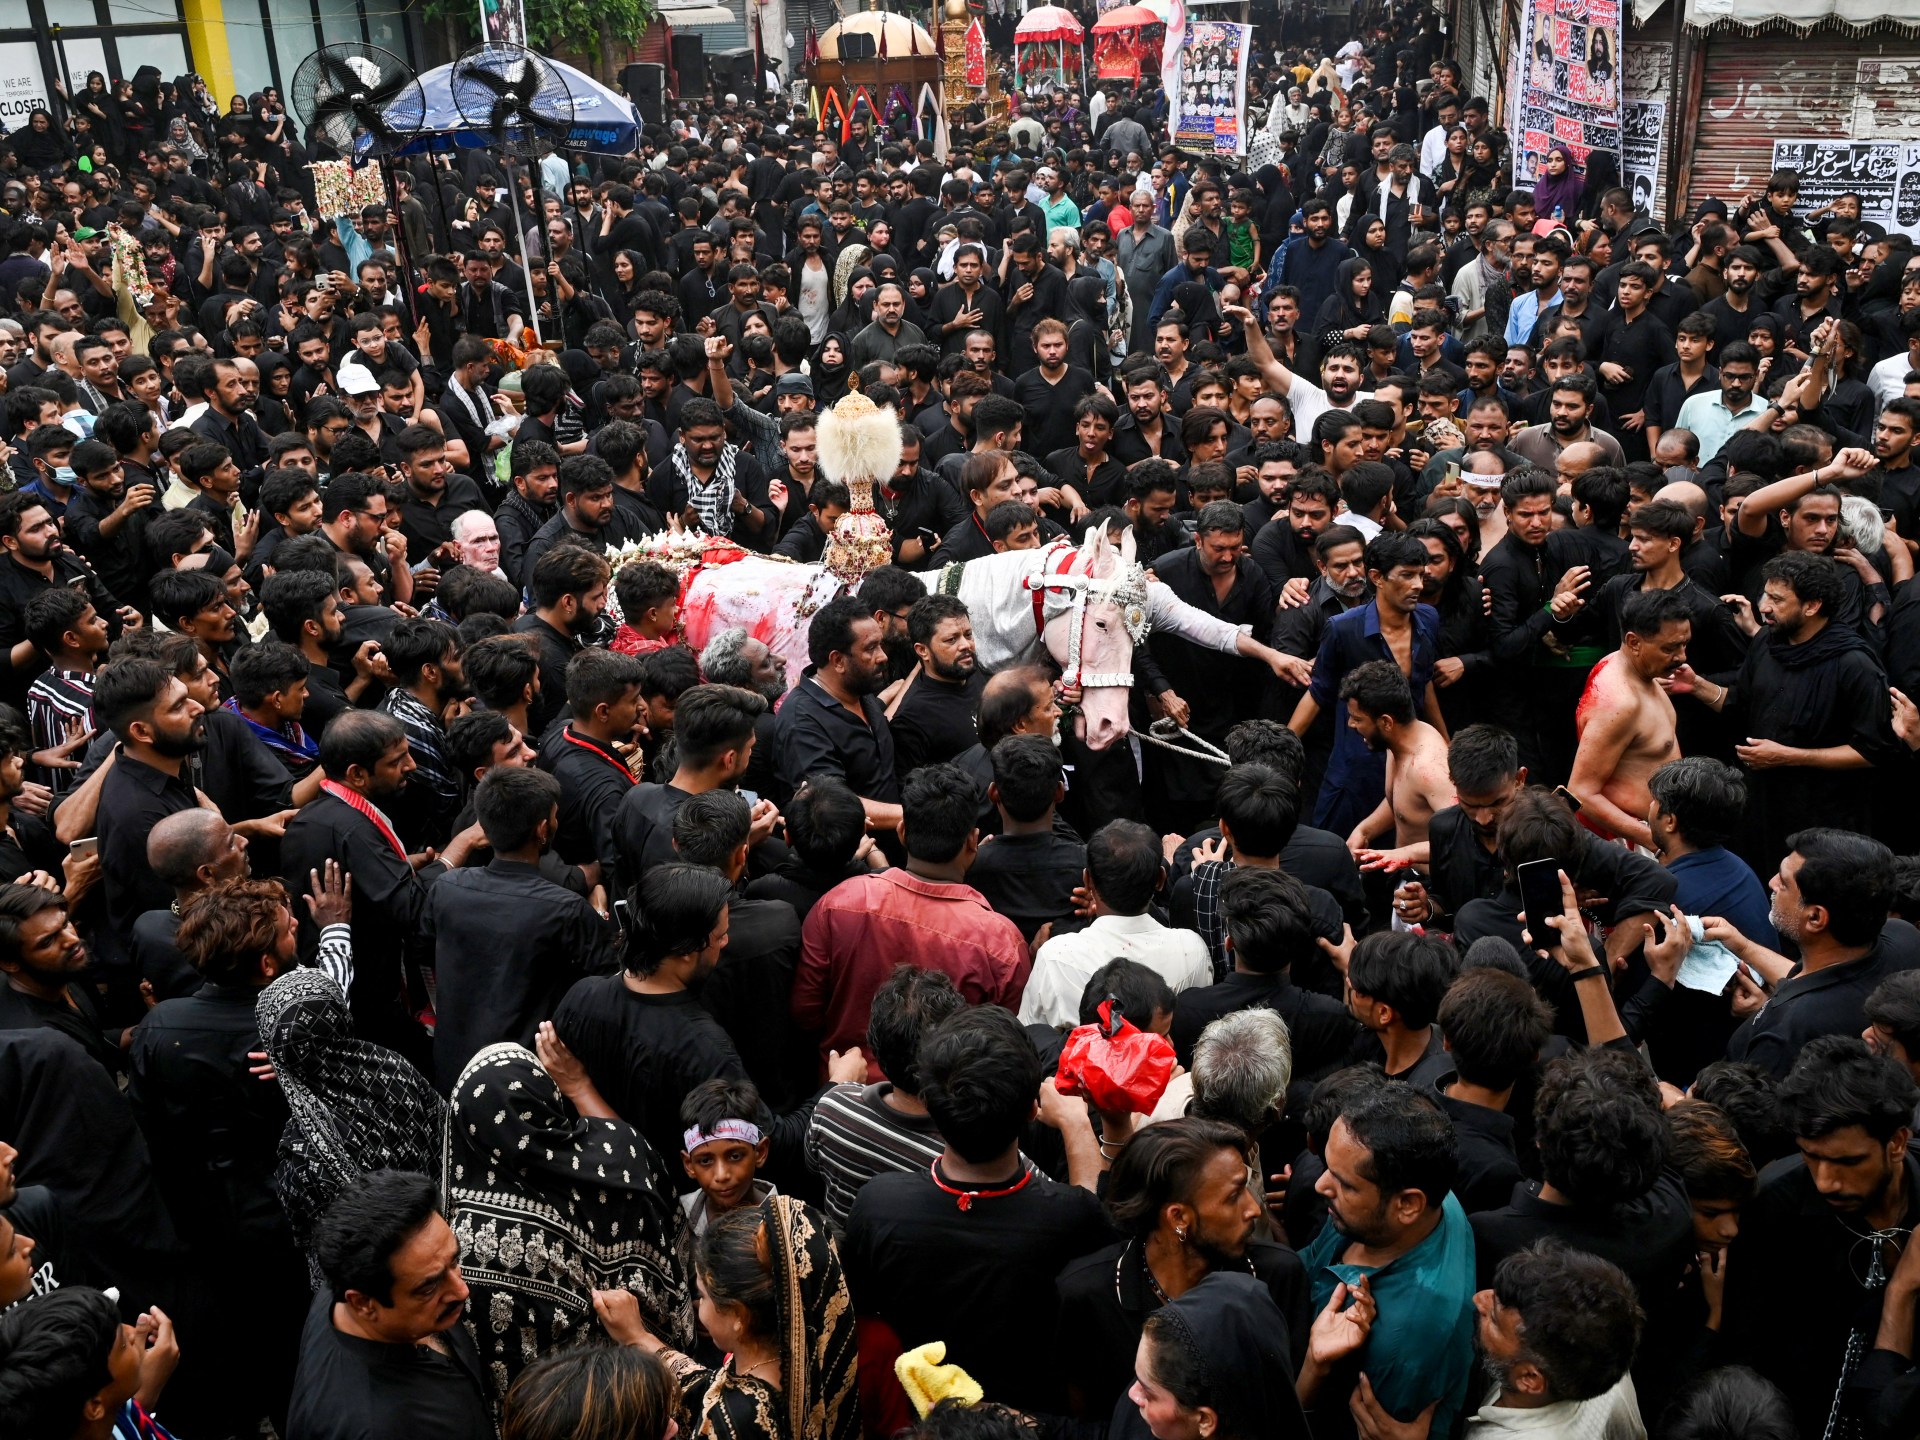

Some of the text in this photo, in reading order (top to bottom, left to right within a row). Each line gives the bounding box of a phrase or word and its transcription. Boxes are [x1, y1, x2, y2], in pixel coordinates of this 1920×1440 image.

[71, 71, 82, 80] WE
[3, 77, 32, 88] WE ARE
[6, 90, 34, 98] TEMPORARILY
[0, 98, 46, 117] CLOSED
[569, 128, 617, 144] newage
[564, 139, 588, 147] CABLES
[1779, 144, 1803, 157] 3 4
